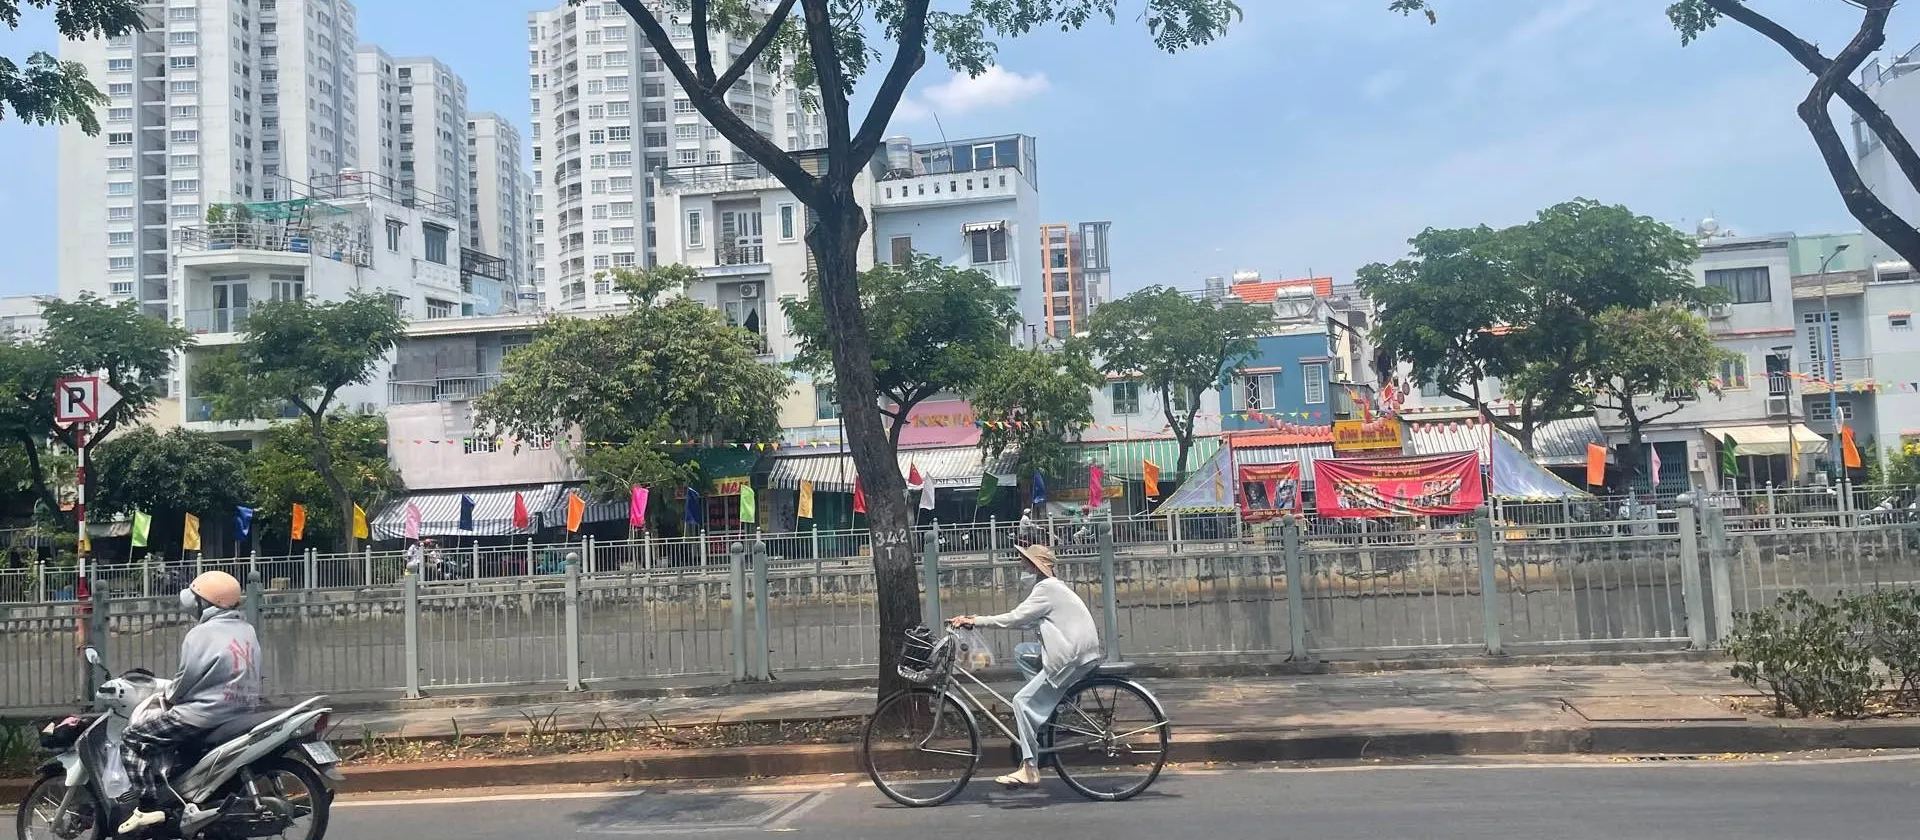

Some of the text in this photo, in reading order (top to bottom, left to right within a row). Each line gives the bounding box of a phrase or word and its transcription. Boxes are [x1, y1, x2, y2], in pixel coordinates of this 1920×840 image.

[68, 387, 86, 413] P
[875, 528, 908, 547] 342
[885, 546, 895, 560] T
